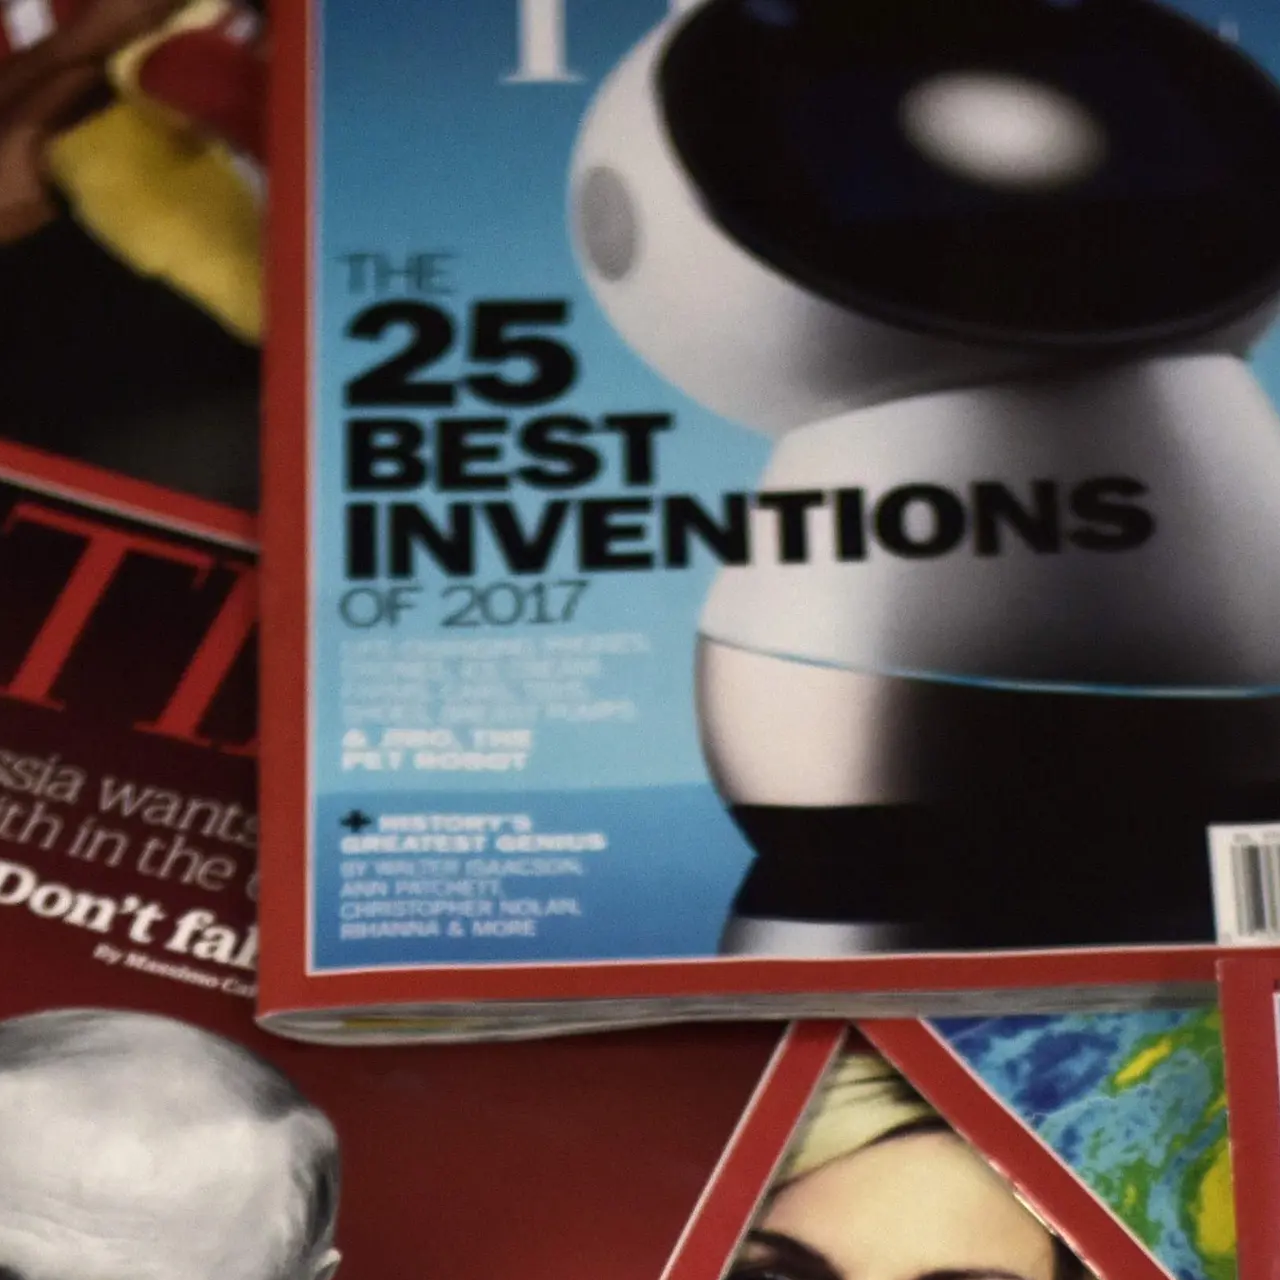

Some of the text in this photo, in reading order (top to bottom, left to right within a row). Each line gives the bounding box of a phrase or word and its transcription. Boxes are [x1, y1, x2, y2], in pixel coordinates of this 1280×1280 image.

[337, 252, 455, 297] THE
[344, 297, 579, 408] 25
[344, 413, 674, 492] BEST
[344, 475, 1155, 579] INVENTIONS
[337, 579, 590, 628] OF 2017
[68, 818, 127, 867] in
[137, 826, 237, 892] the
[472, 918, 536, 937] MORE
